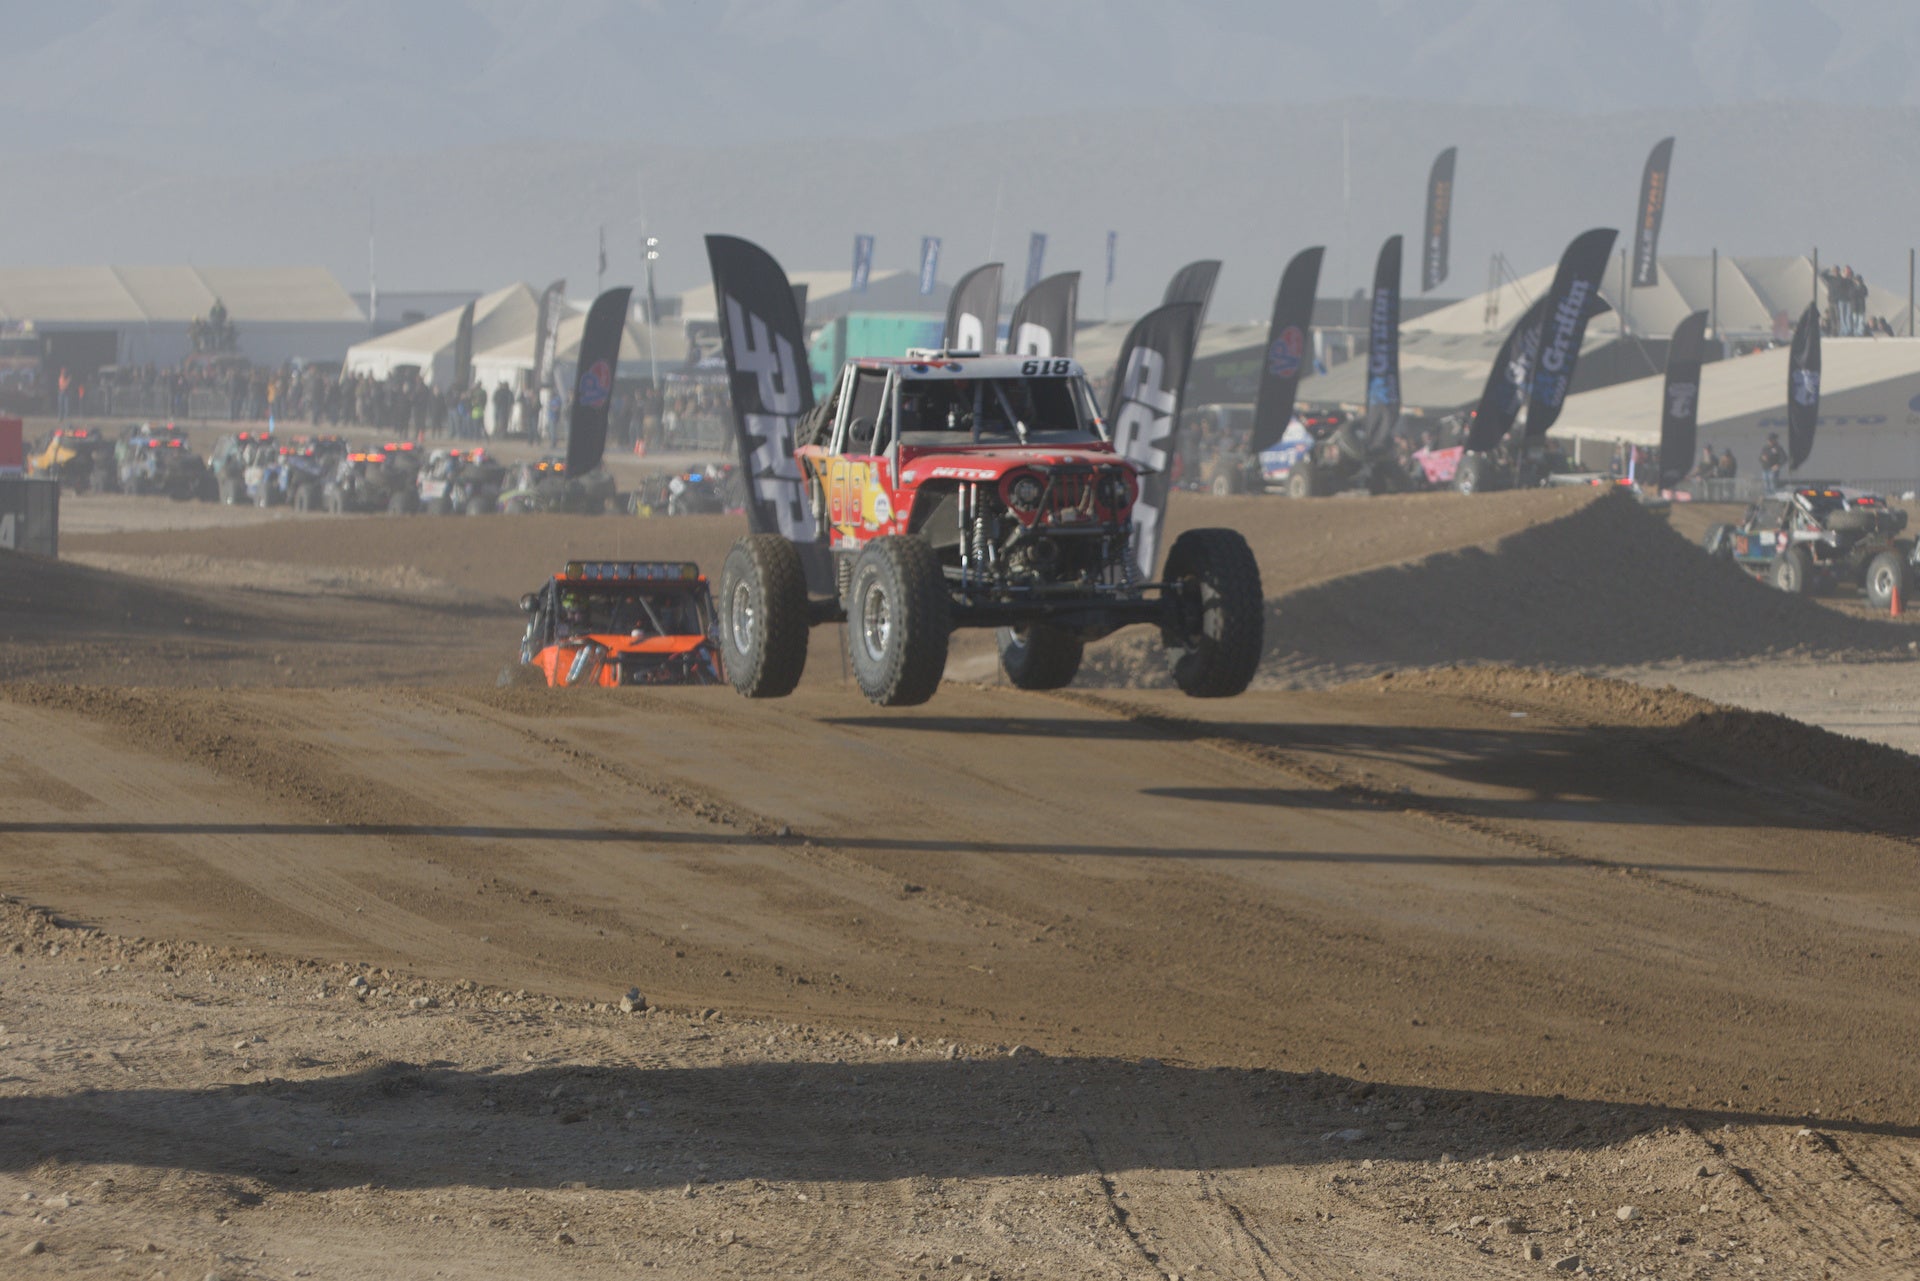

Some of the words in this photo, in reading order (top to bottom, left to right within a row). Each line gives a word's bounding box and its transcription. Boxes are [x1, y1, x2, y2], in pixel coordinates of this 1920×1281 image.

[1541, 279, 1591, 372] Griffin
[1022, 360, 1070, 375] 618
[931, 466, 997, 479] NITTO
[830, 460, 865, 527] 618
